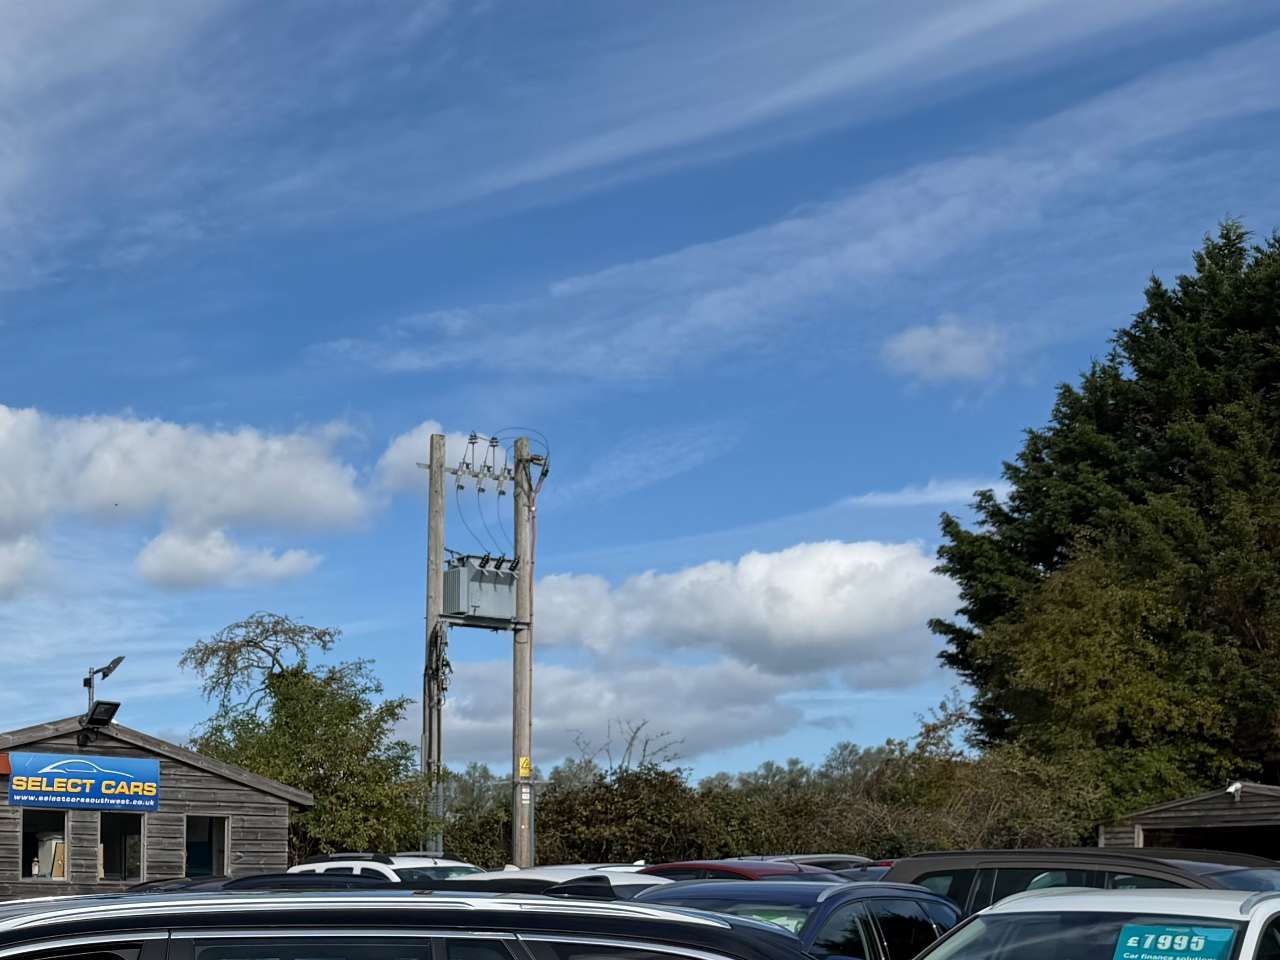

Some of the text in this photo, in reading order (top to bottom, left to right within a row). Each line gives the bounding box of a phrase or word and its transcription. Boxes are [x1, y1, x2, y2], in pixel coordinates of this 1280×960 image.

[12, 776, 157, 796] SELECT CARS
[1126, 934, 1206, 951] £7995
[1123, 952, 1140, 960] Car
